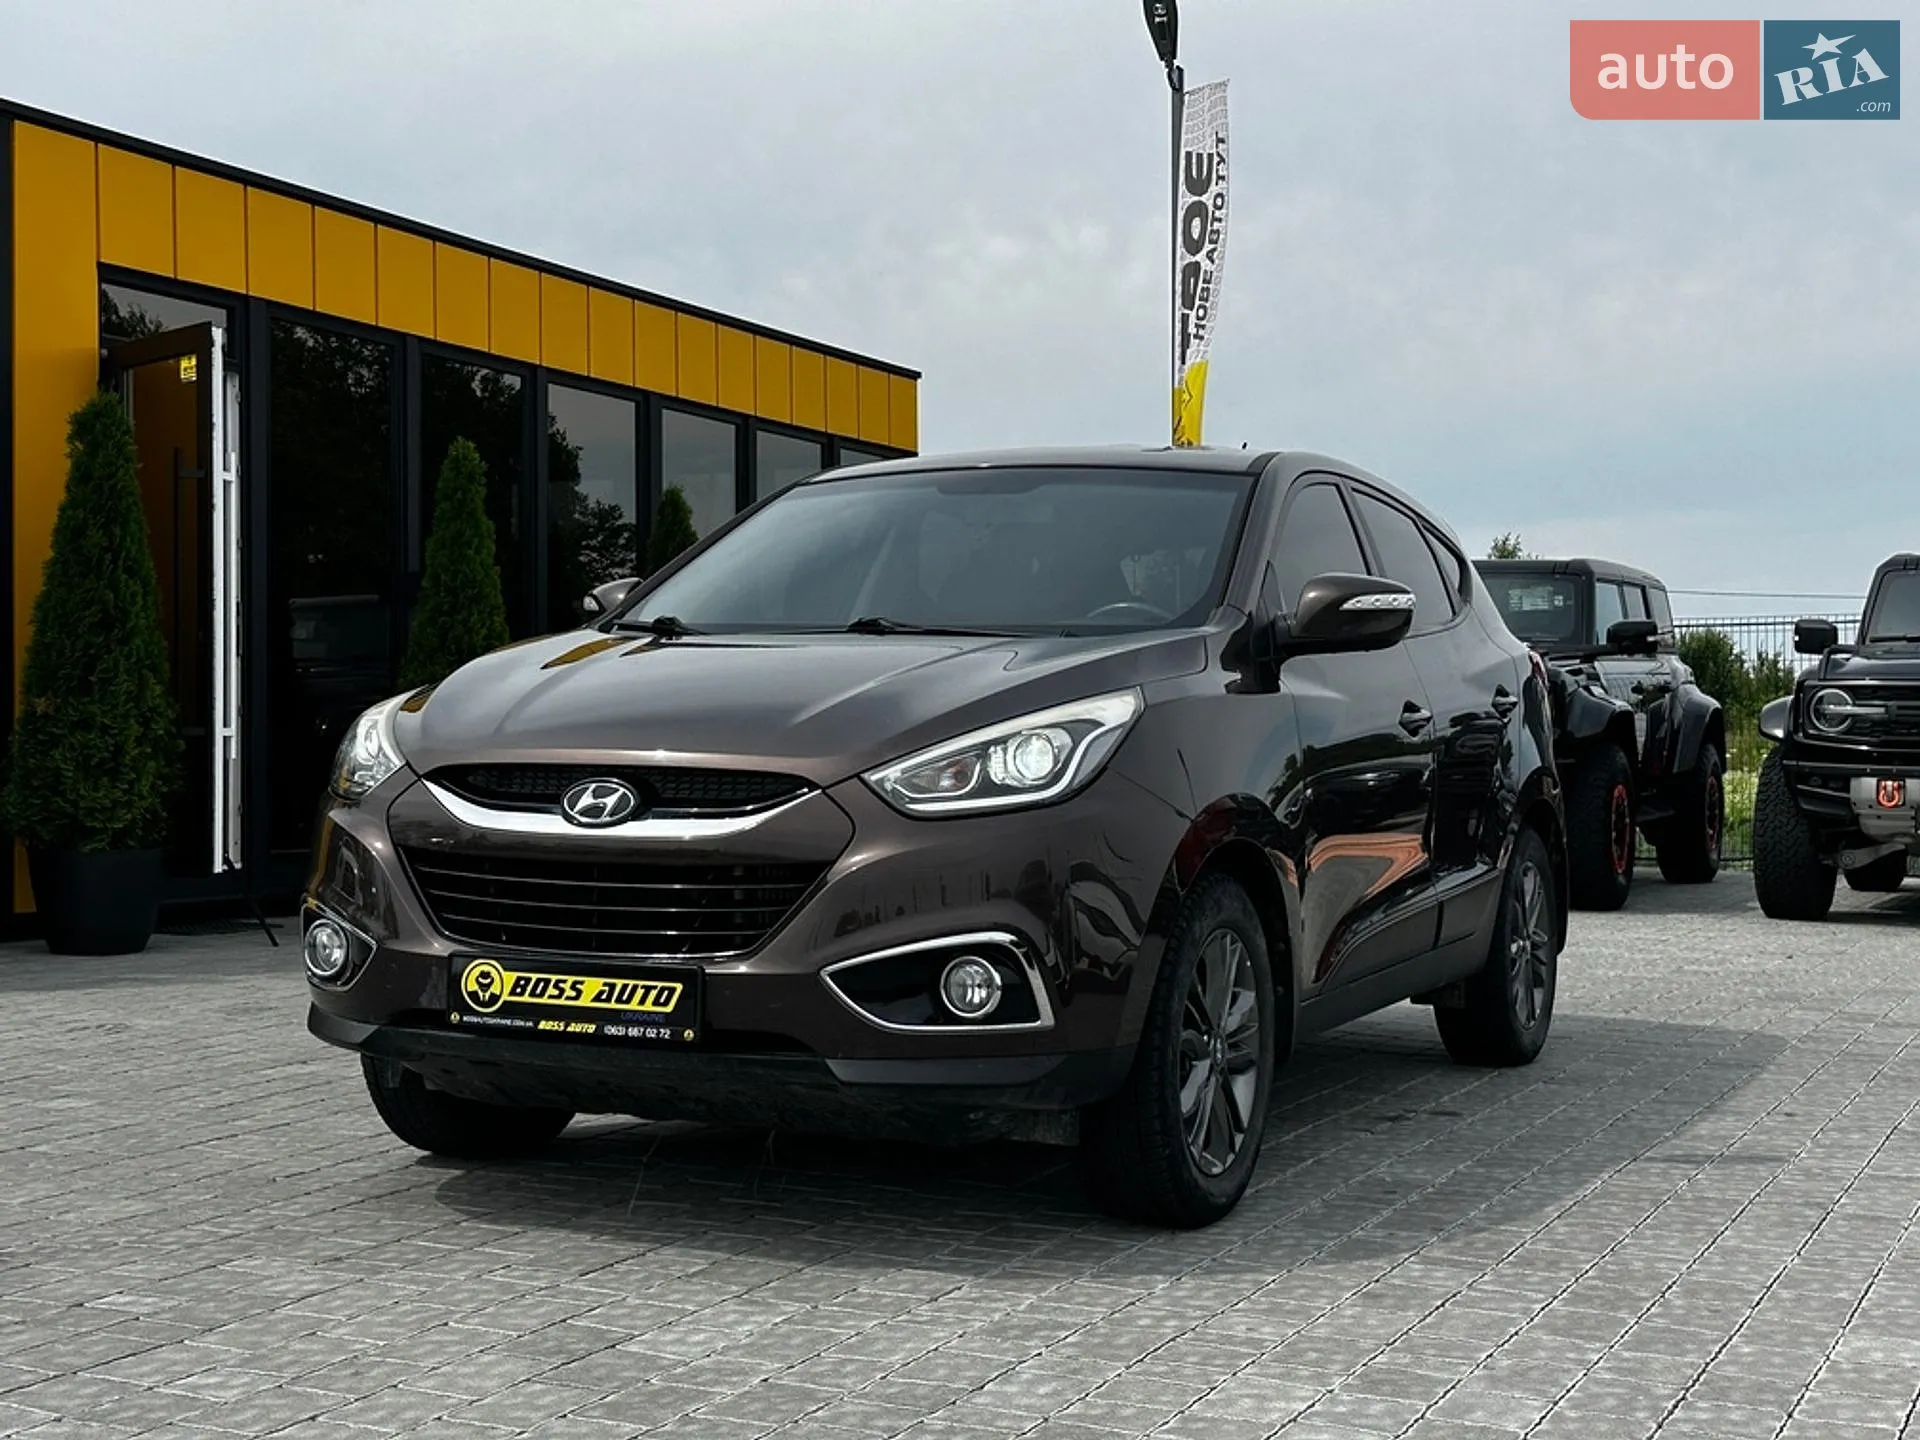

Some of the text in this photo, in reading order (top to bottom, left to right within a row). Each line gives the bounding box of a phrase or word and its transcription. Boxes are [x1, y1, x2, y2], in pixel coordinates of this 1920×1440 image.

[1192, 268, 1214, 341] НОВЕ
[1205, 192, 1225, 265] АВТО
[1215, 130, 1227, 187] ТУТ
[507, 975, 678, 1008] BOSS AUTO
[537, 1020, 597, 1034] BOSS AUTO
[658, 1029, 672, 1040] 72
